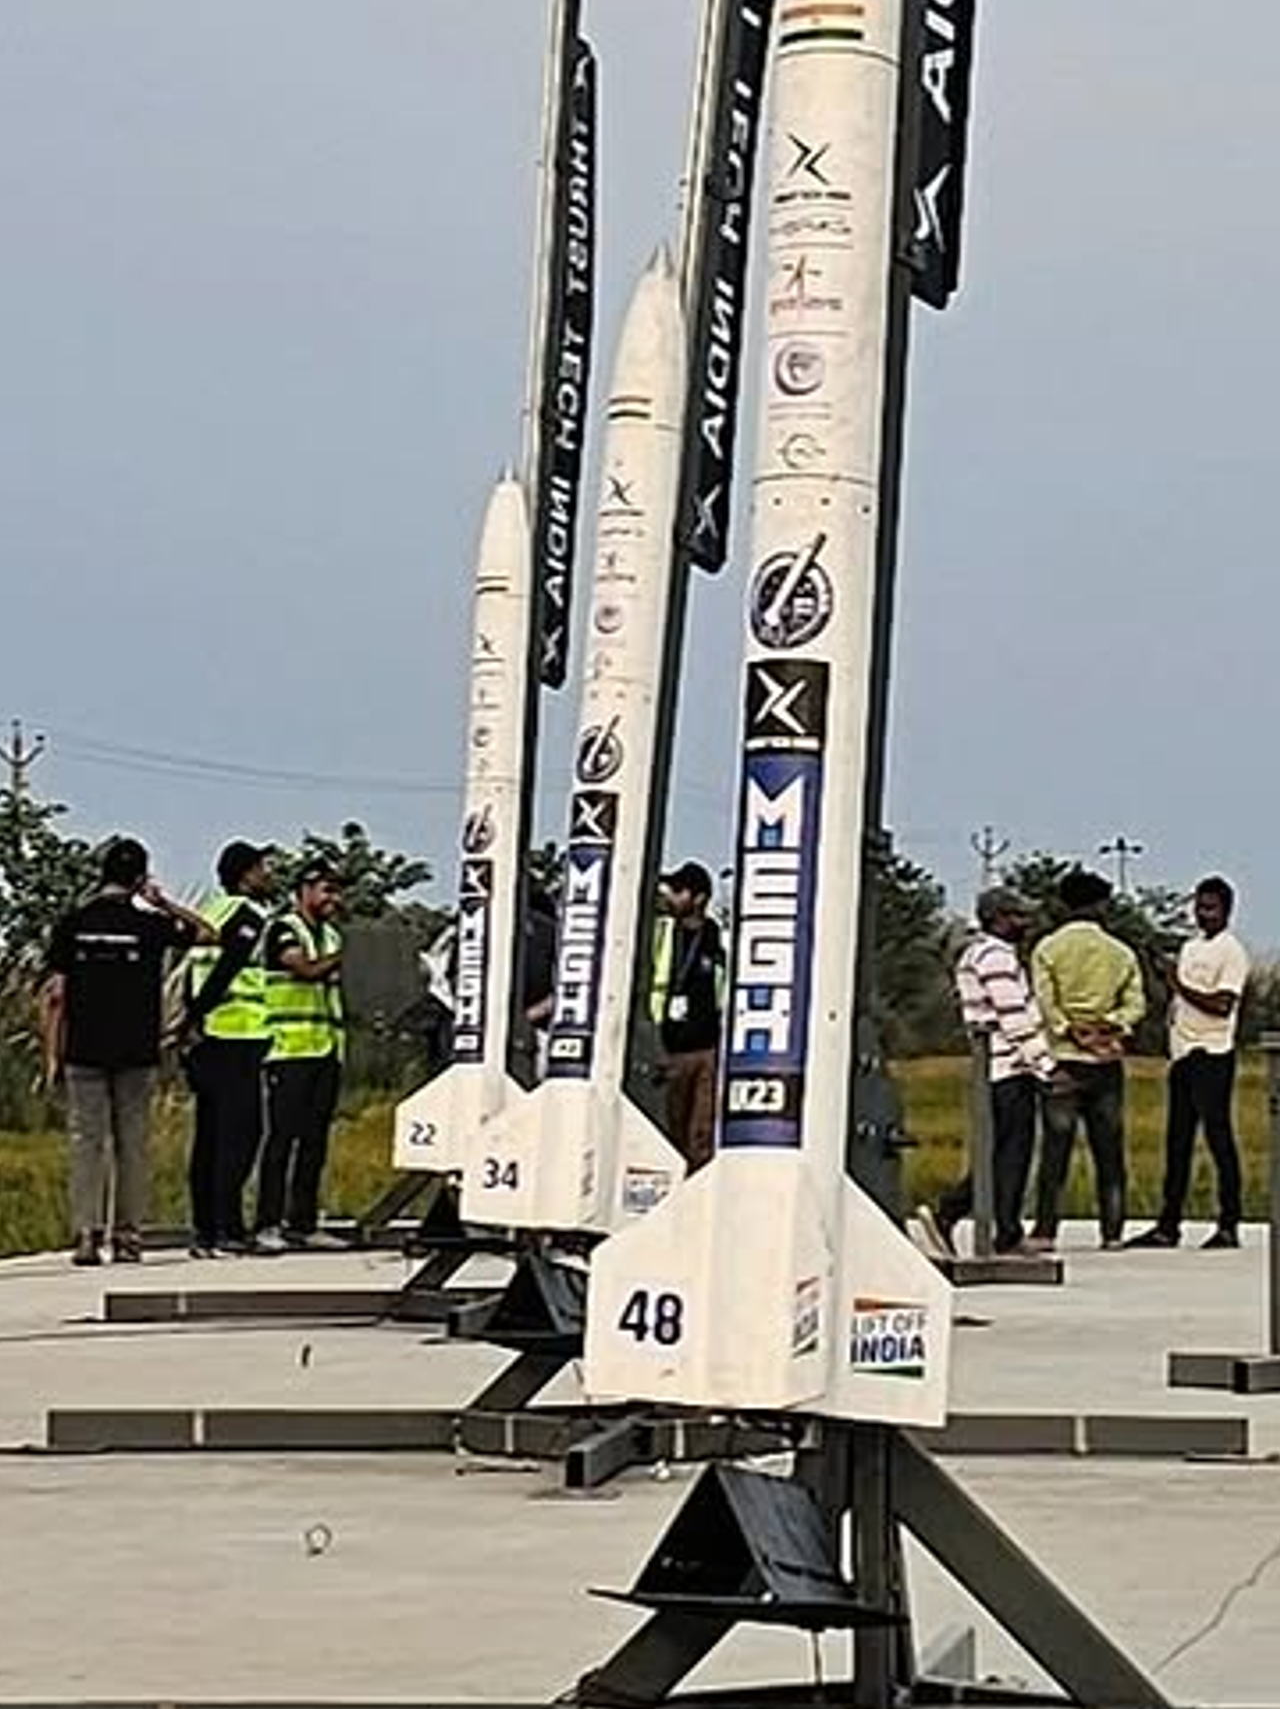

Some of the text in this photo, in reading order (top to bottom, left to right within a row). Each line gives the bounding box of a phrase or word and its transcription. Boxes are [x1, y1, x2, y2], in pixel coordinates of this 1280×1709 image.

[732, 776, 803, 1054] MEGH
[555, 859, 602, 1024] MEGH
[410, 1121, 436, 1145] 22
[482, 1157, 518, 1190] 34
[618, 1289, 684, 1346] 48
[850, 1335, 926, 1364] INDIA
